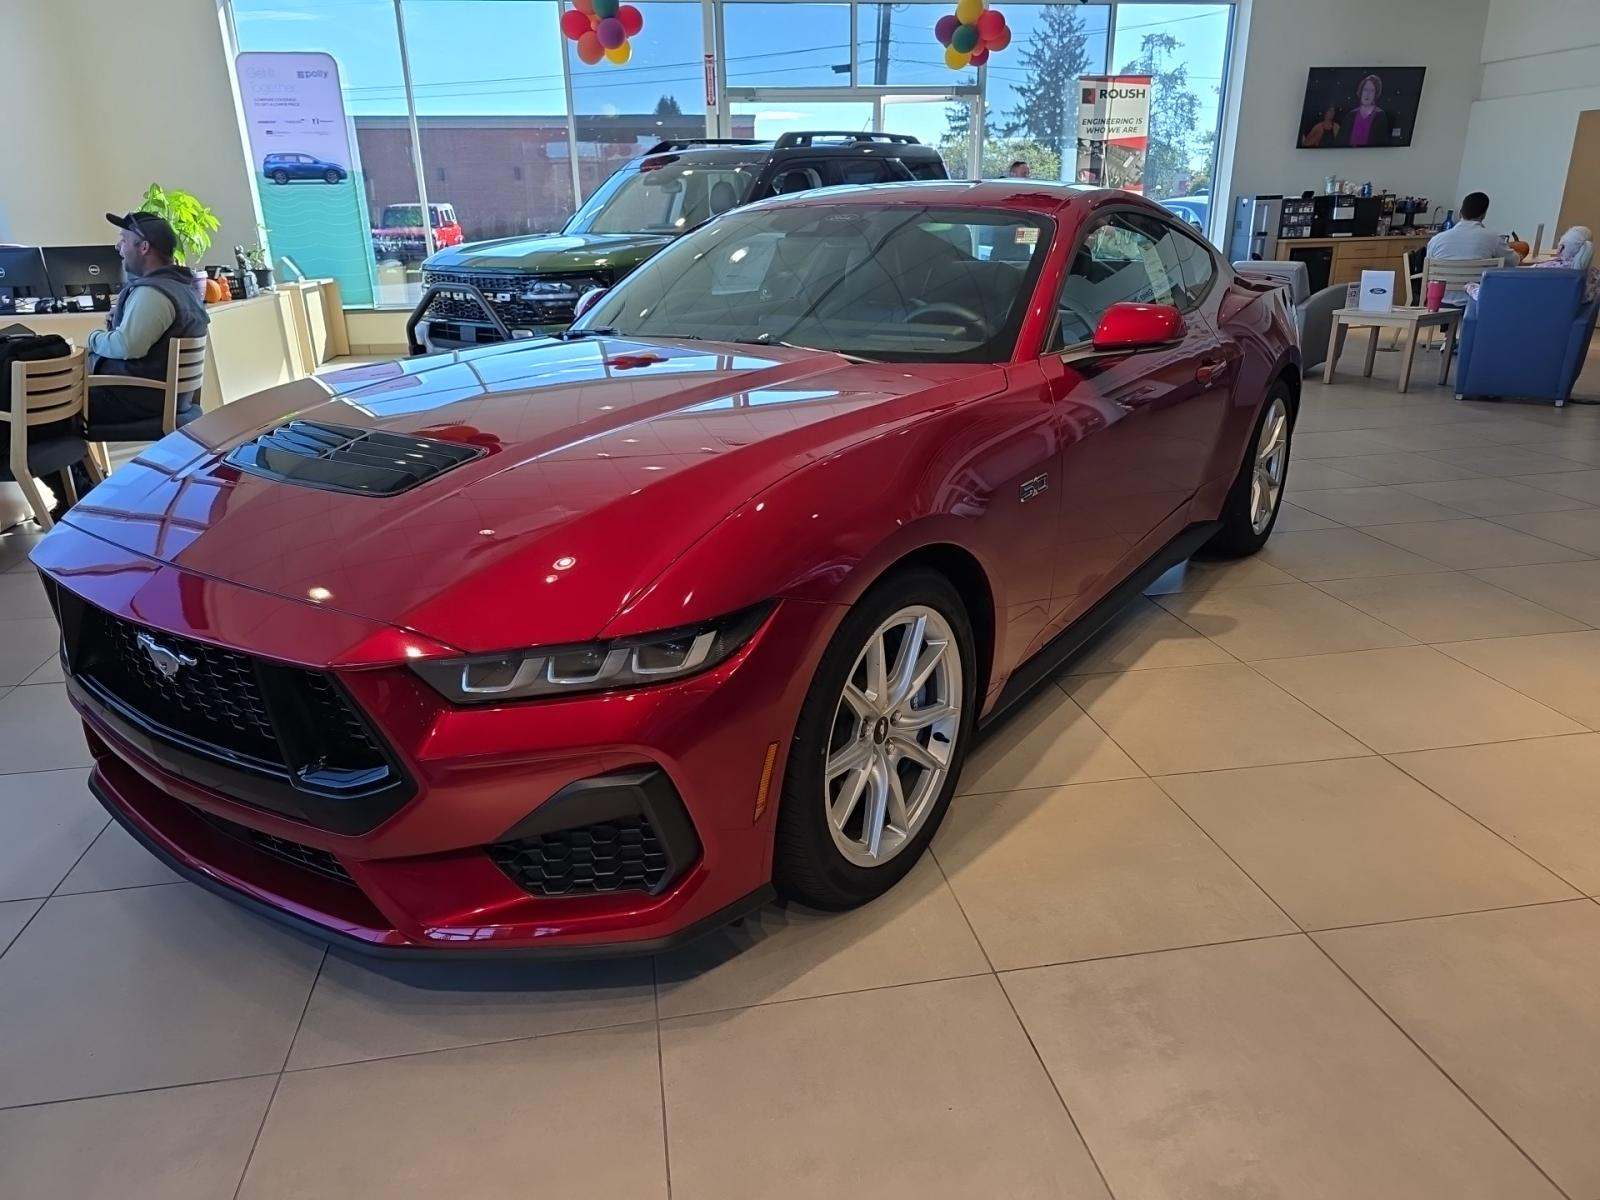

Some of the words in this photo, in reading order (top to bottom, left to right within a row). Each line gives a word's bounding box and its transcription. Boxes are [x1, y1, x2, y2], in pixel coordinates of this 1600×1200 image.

[305, 70, 328, 79] polly
[1099, 89, 1146, 99] ROUSH
[1081, 117, 1134, 126] ENGINEERING
[1135, 117, 1144, 126] IS
[1086, 126, 1106, 135] WHO
[1107, 126, 1121, 134] WE
[1121, 126, 1139, 134] ARE
